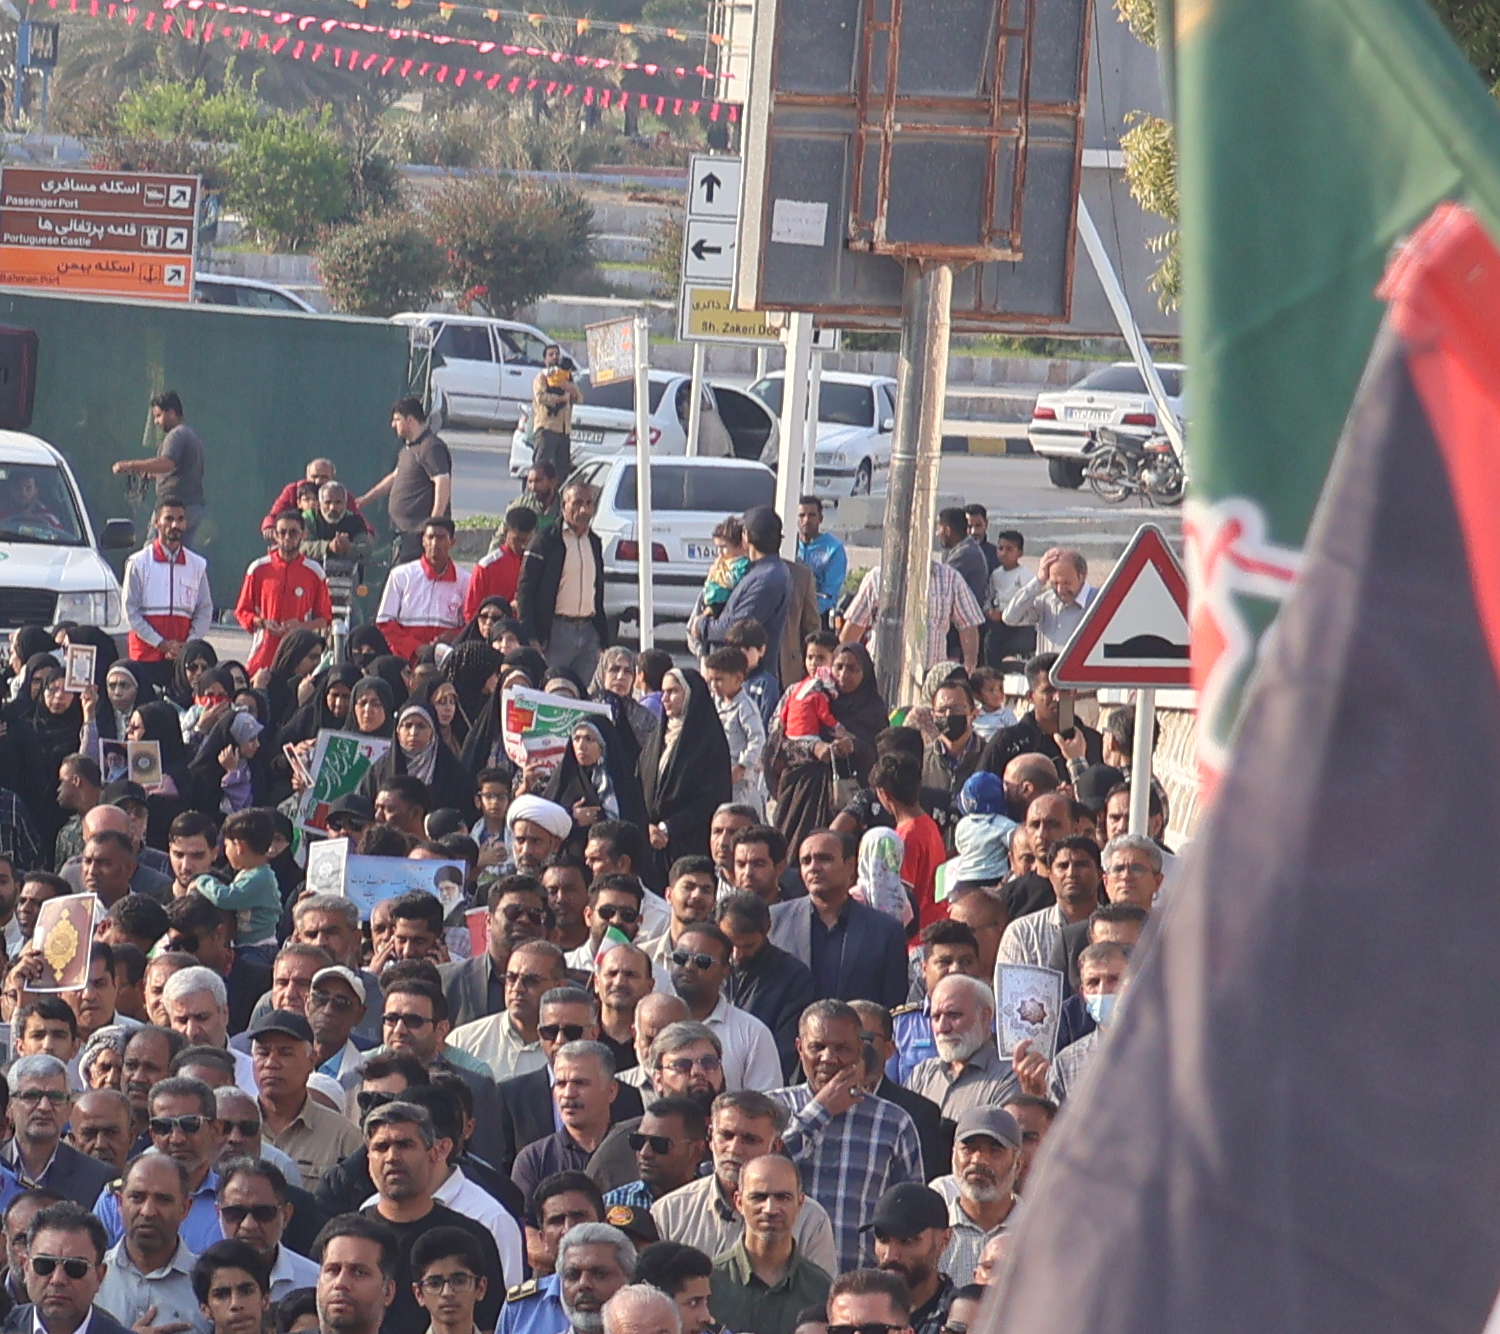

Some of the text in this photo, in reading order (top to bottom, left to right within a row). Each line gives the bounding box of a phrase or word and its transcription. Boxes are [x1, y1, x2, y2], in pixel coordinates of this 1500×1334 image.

[41, 177, 140, 195] اسکله مسافری
[5, 195, 79, 209] Passenger Port
[38, 216, 53, 232] ها
[107, 221, 137, 237] قلعه
[3, 232, 92, 247] Portuguese Castle
[94, 261, 135, 274] اسکله
[40, 274, 60, 286] Port
[722, 322, 757, 335] Zakeri
